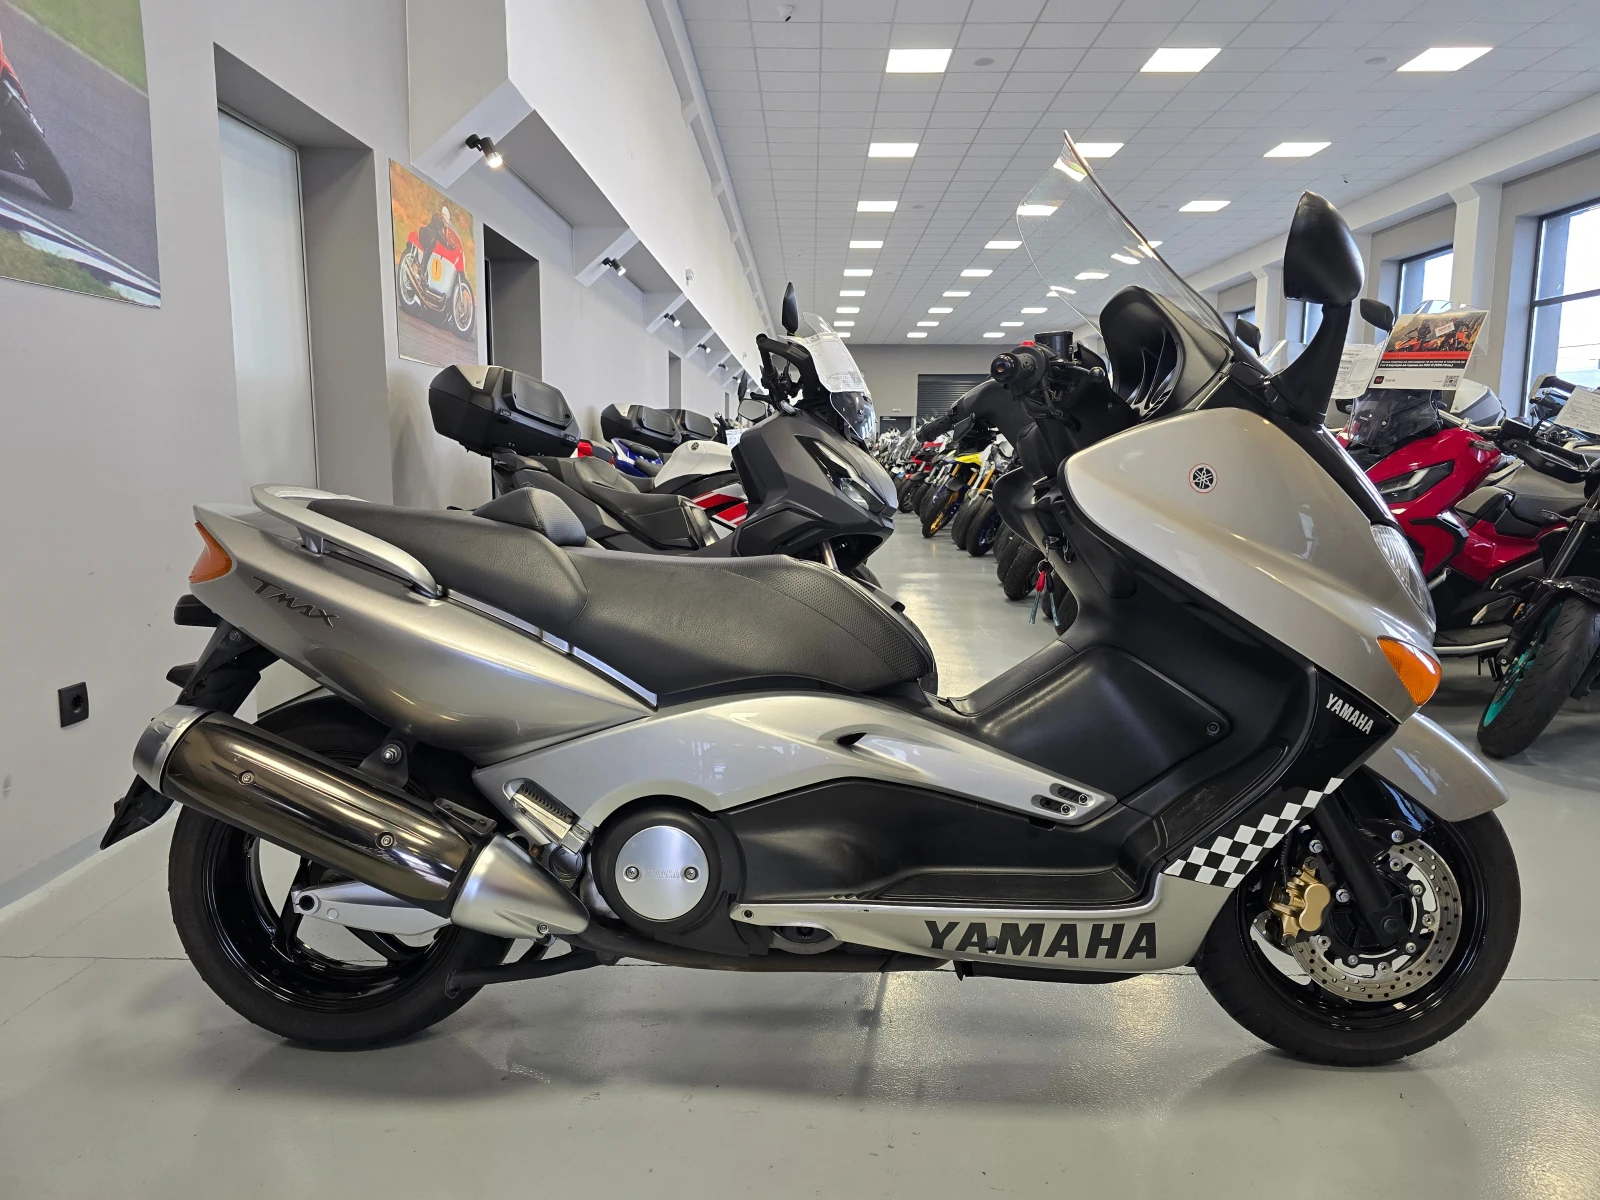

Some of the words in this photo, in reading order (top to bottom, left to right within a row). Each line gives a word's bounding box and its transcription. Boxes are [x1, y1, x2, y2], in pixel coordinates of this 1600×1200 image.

[252, 575, 340, 627] TMAX
[1325, 693, 1374, 735] YAMAHA
[924, 920, 1157, 960] YAMAHA
